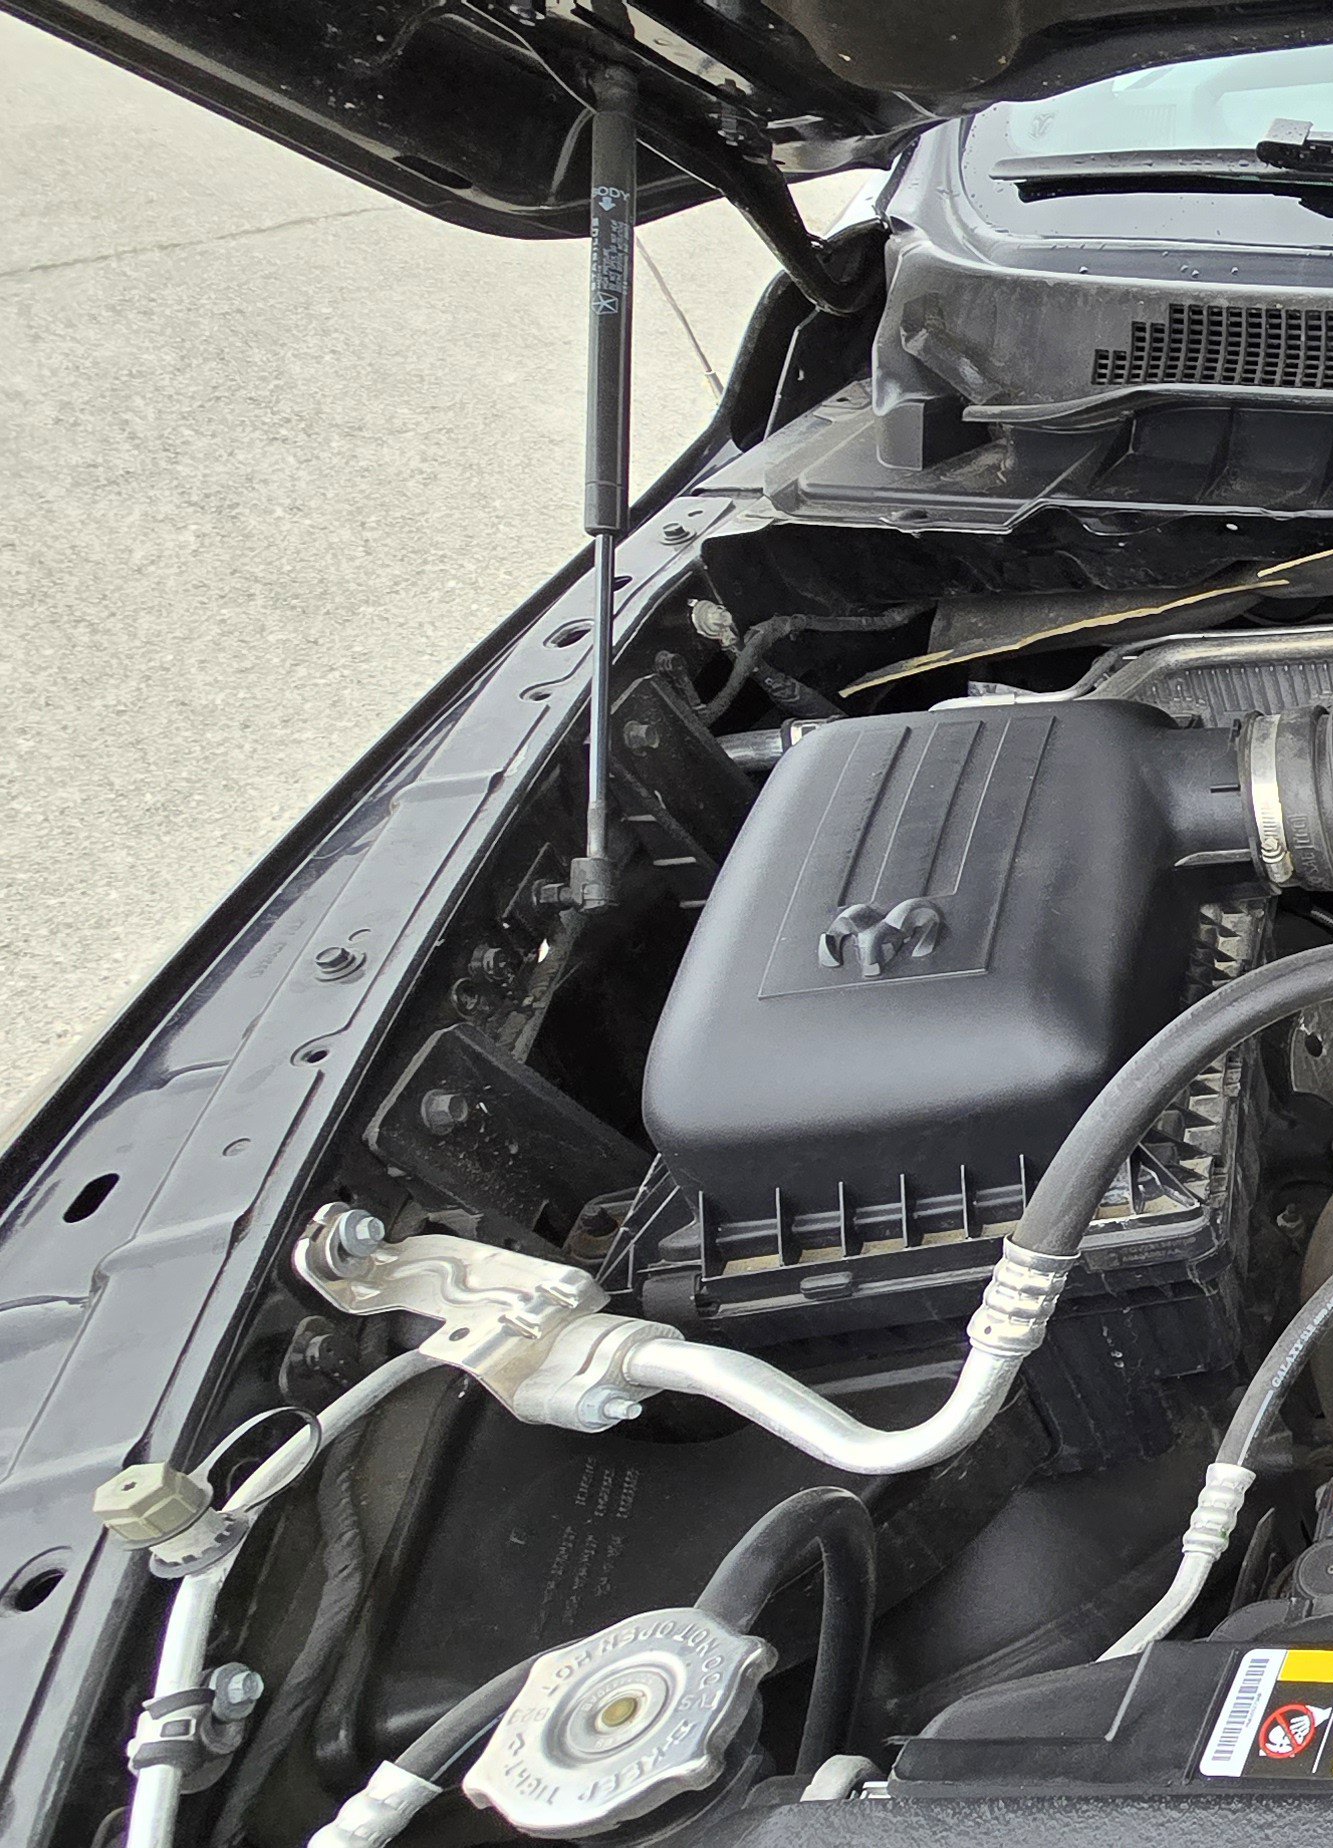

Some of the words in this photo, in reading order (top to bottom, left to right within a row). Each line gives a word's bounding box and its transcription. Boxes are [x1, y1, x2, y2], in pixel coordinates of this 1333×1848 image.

[1272, 1339, 1303, 1388] GALAXY
[599, 1619, 674, 1654] OPEN
[675, 1627, 719, 1660] NOT
[541, 1649, 593, 1698] HOT
[578, 1747, 667, 1802] KEEP
